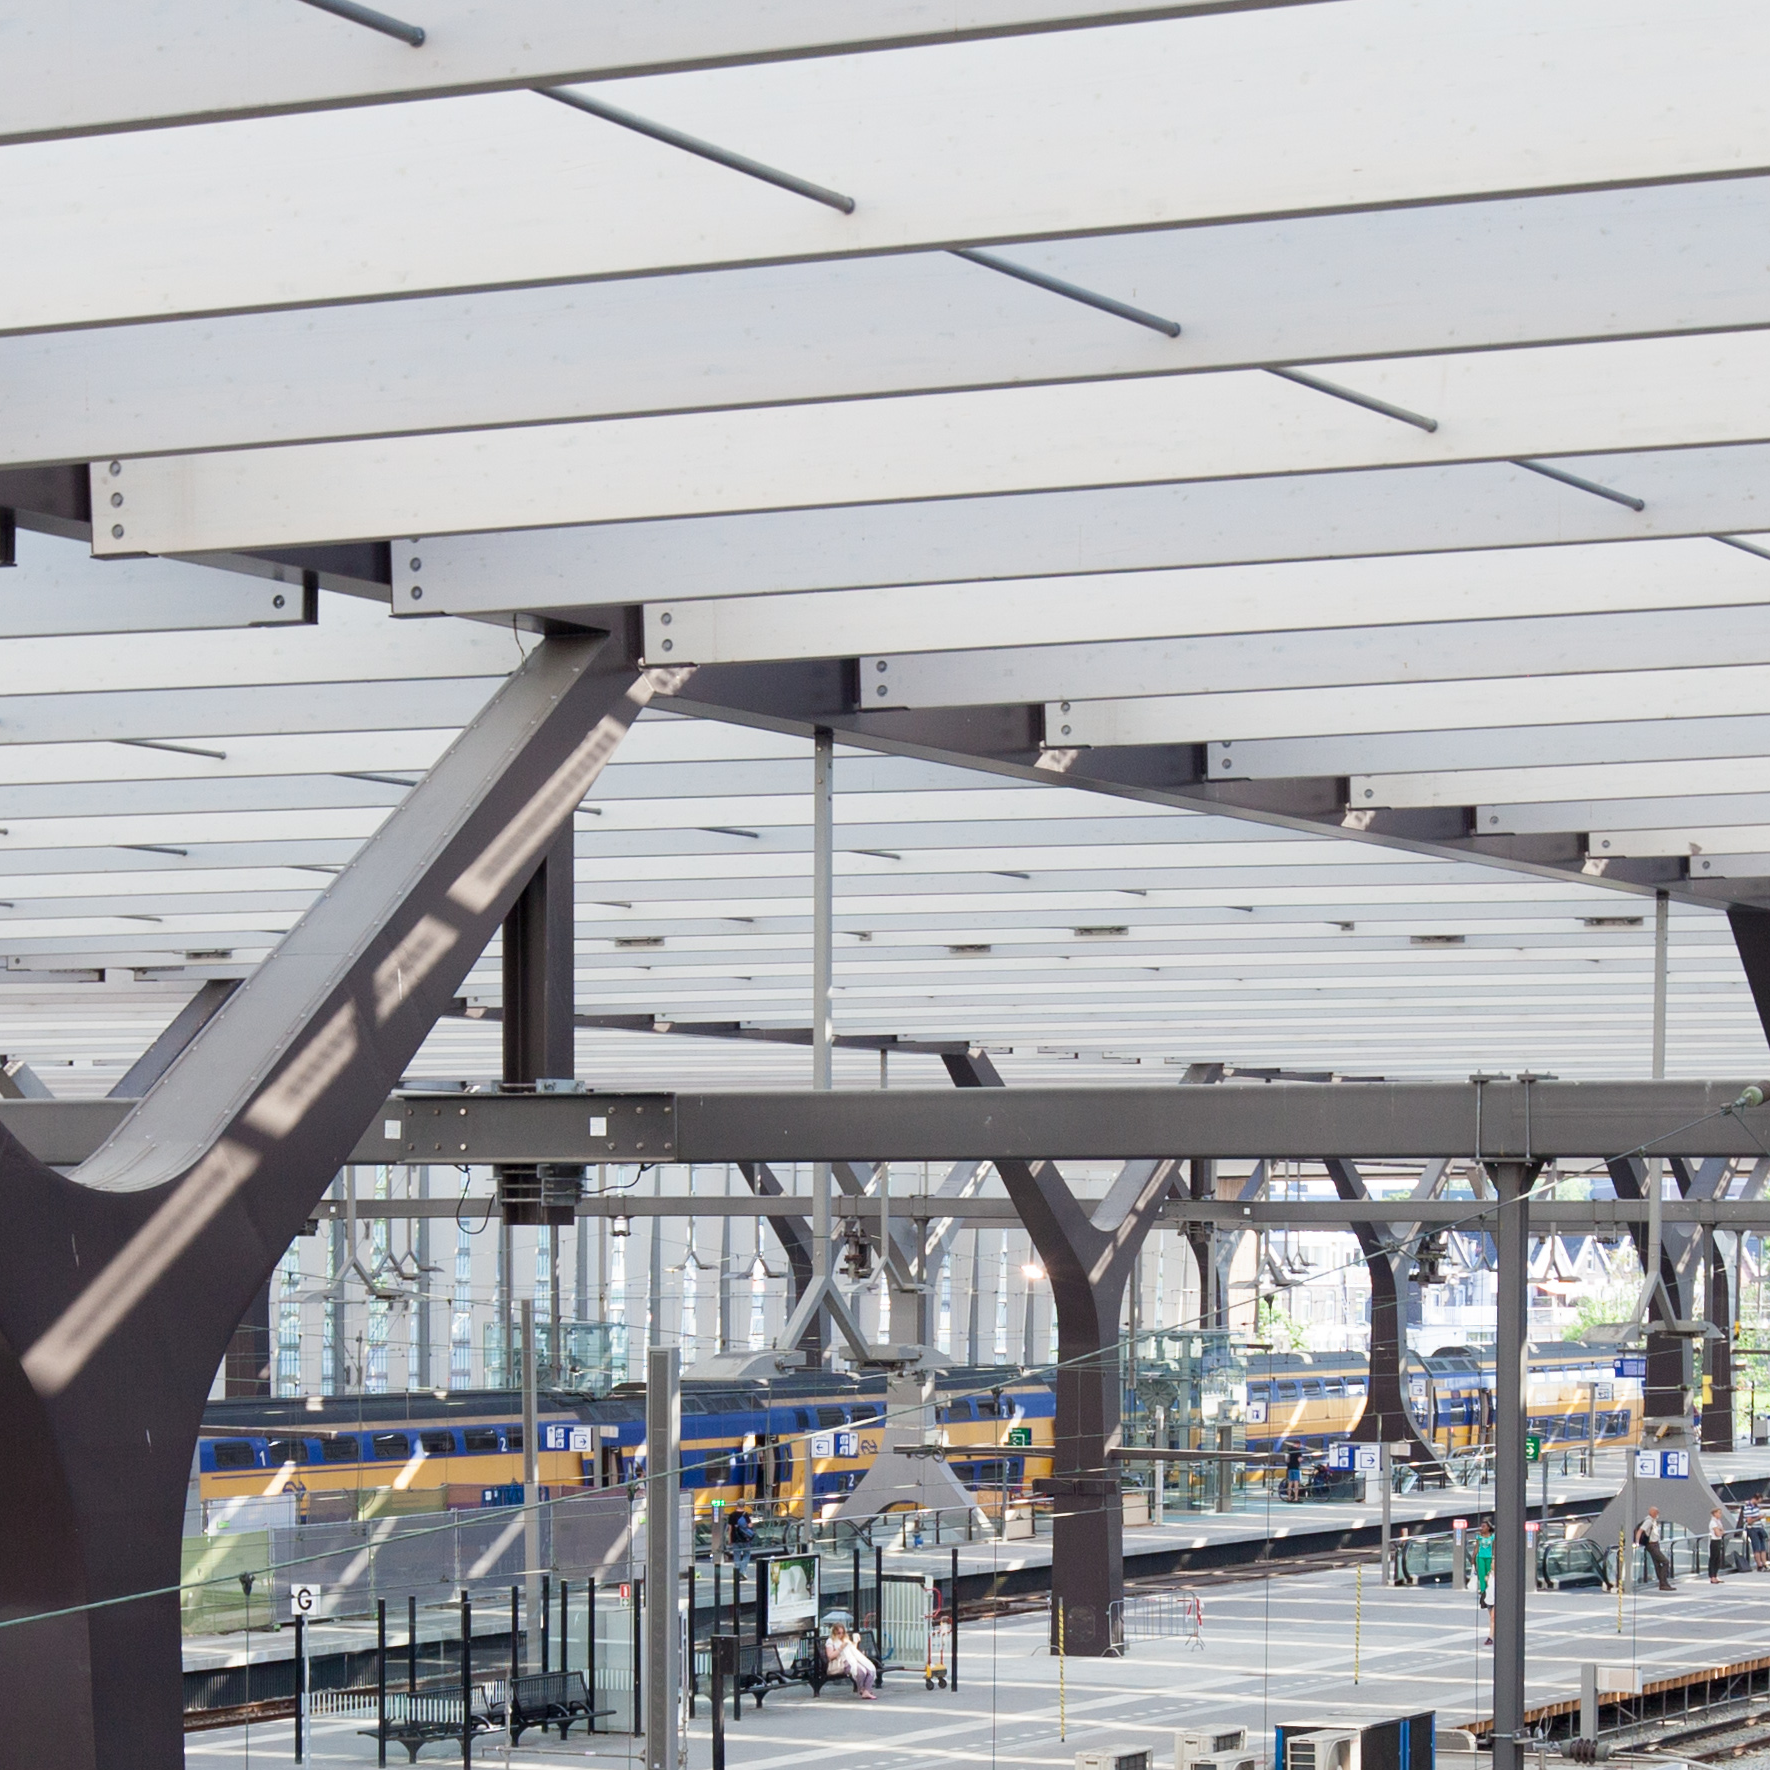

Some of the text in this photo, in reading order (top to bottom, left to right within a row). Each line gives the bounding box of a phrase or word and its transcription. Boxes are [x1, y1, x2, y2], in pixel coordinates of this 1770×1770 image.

[500, 1437, 508, 1452] 2
[259, 1450, 266, 1467] 1
[848, 1473, 854, 1487] 2
[297, 1588, 312, 1611] G
